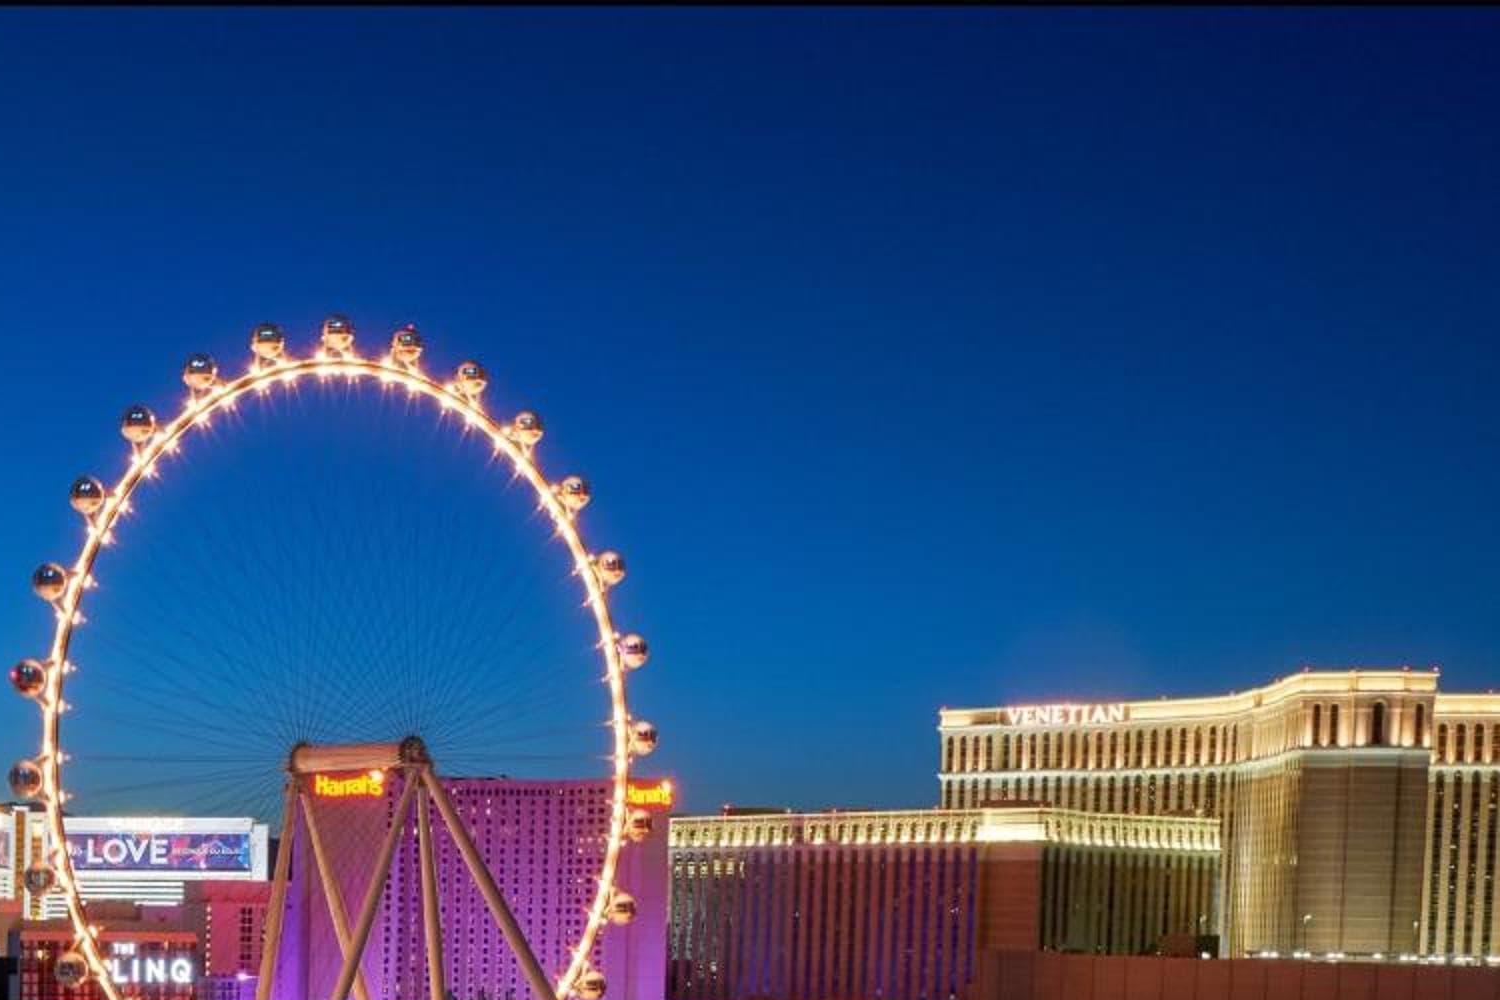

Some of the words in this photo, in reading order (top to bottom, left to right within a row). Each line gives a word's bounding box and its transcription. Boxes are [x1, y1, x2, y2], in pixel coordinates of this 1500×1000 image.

[1008, 703, 1125, 725] VENETIAN
[87, 838, 169, 865] LOVE
[112, 957, 193, 984] LINQ
